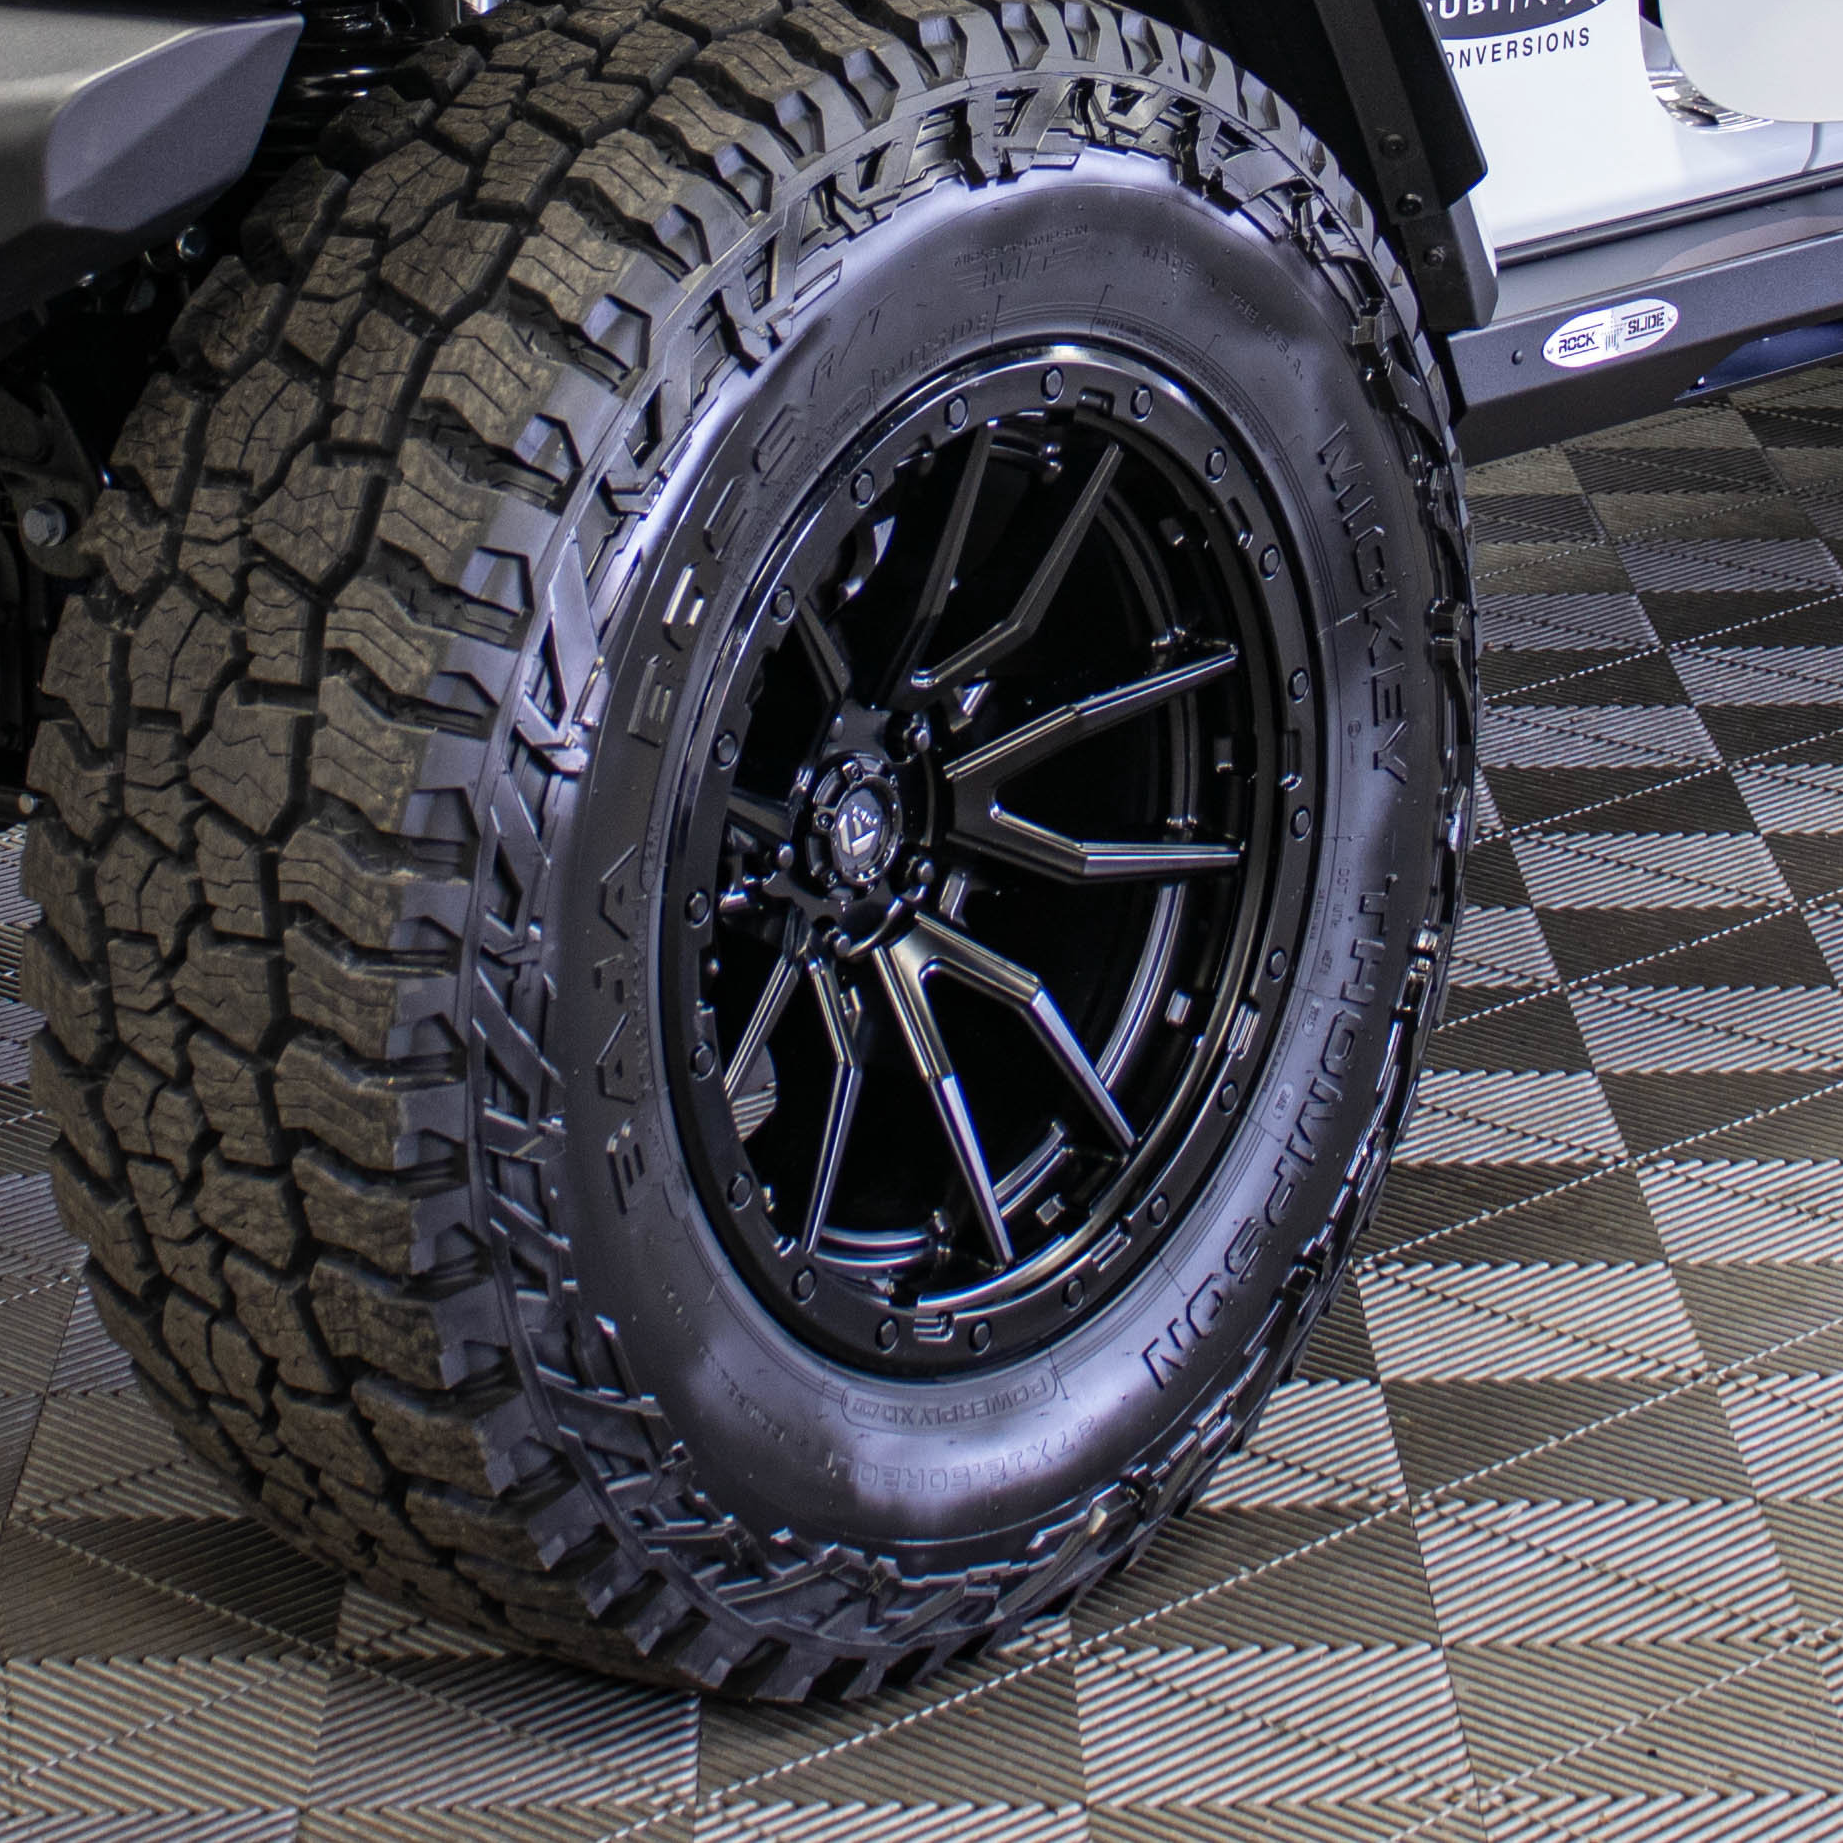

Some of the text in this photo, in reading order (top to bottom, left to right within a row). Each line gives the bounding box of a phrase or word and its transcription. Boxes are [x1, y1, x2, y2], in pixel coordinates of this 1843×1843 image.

[1445, 26, 1590, 69] ONVERSIONS
[1558, 311, 1665, 354] ROCK SLIDE
[1142, 422, 1408, 1390] MICKEY THOMPSON
